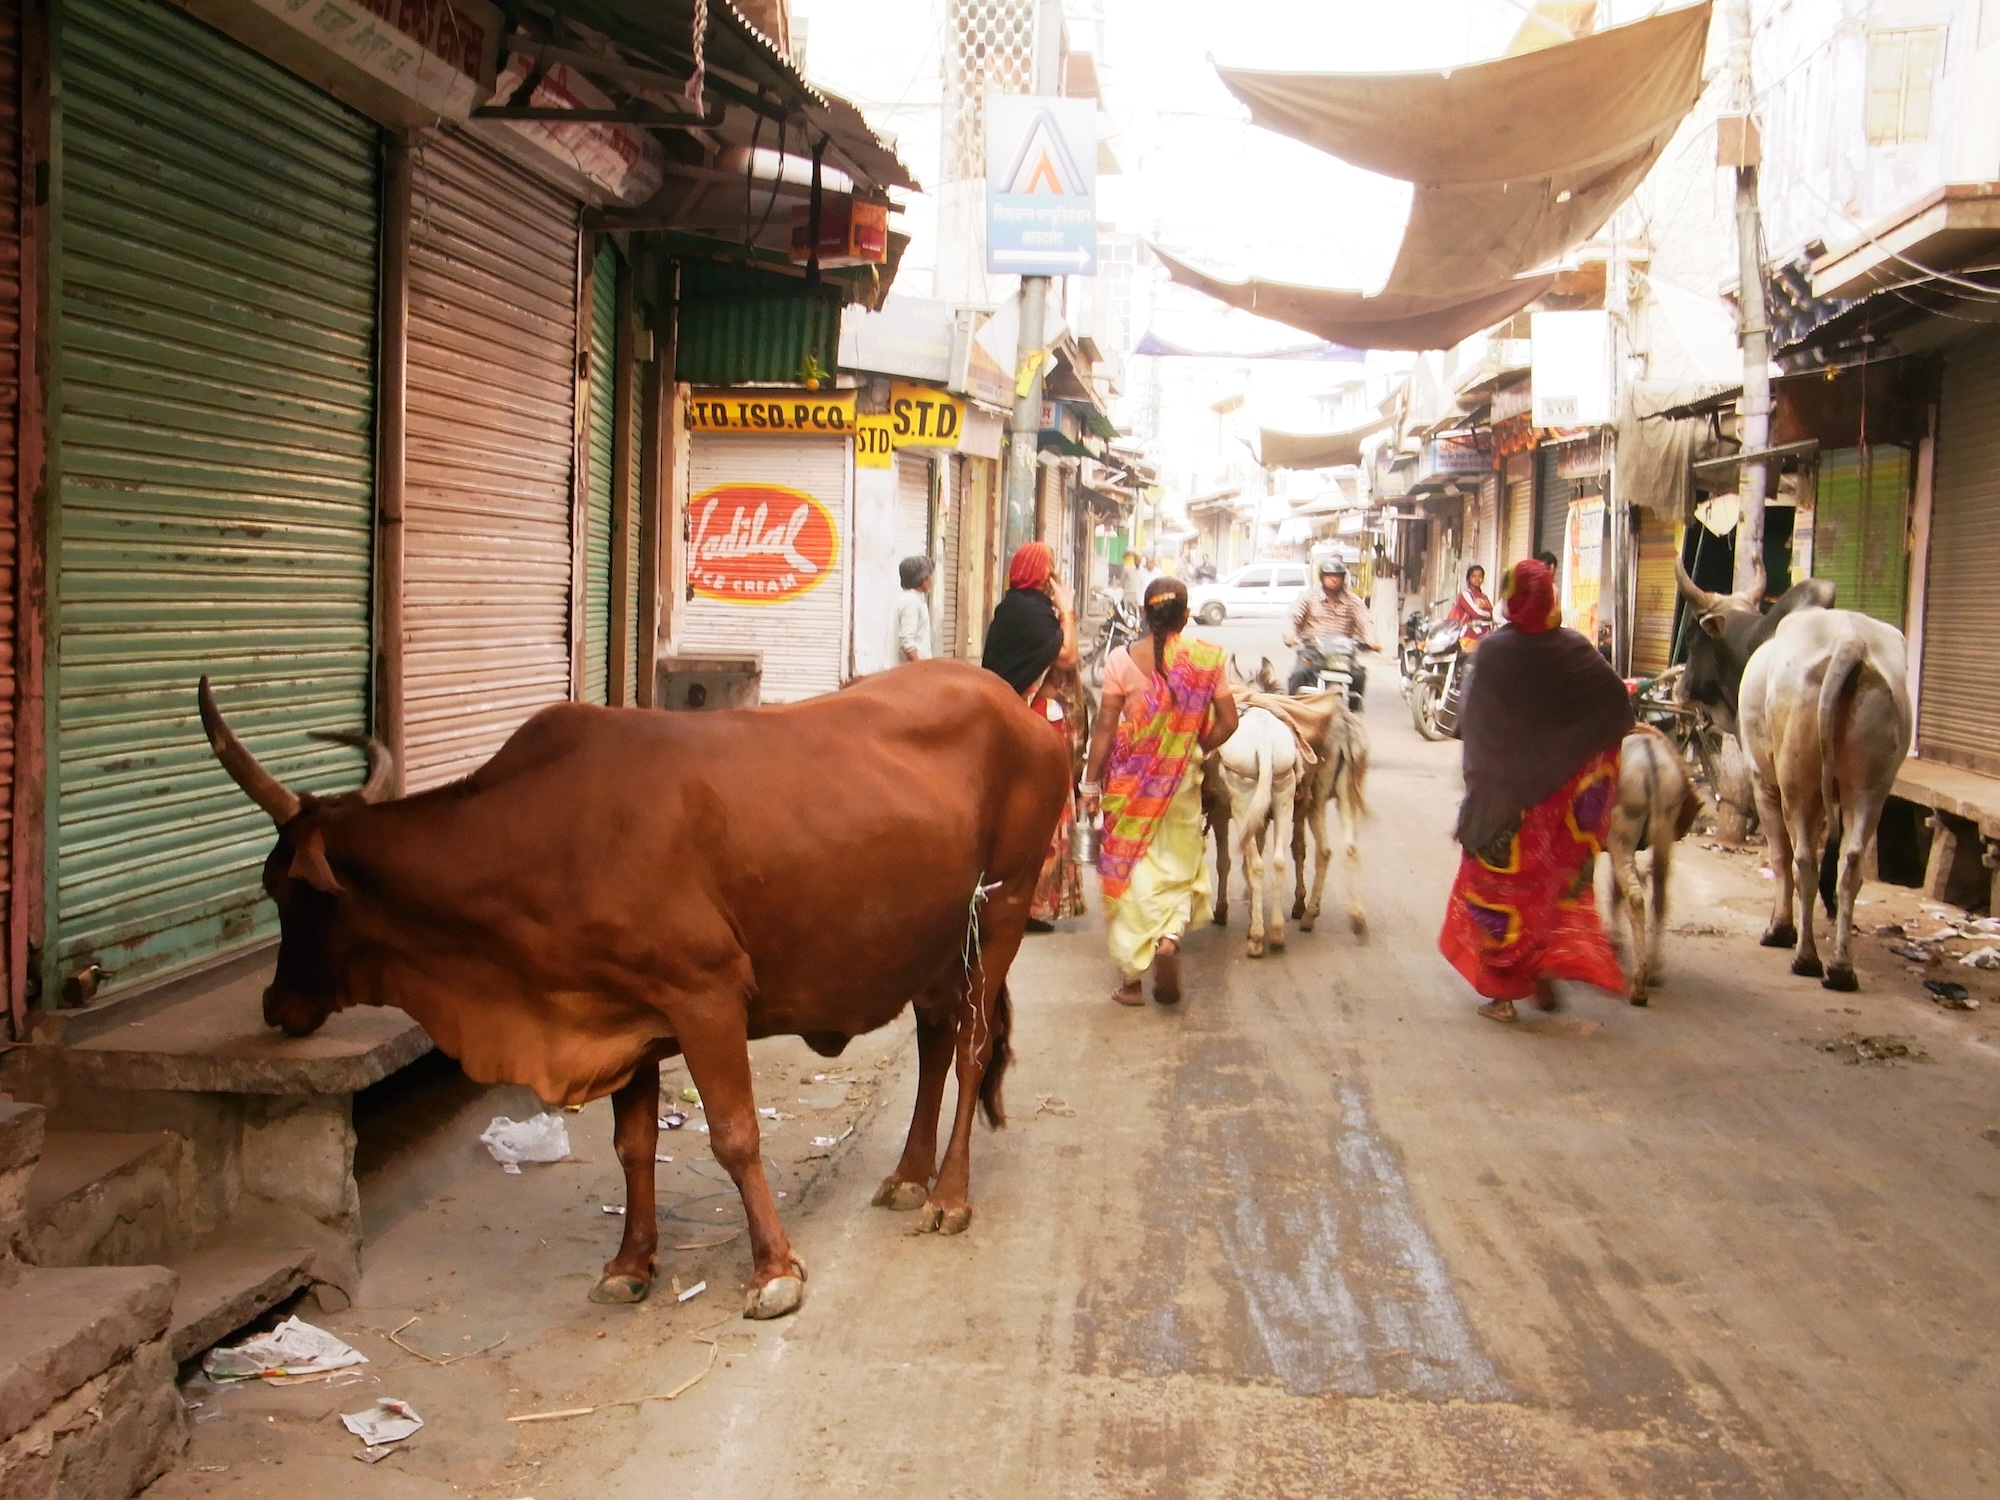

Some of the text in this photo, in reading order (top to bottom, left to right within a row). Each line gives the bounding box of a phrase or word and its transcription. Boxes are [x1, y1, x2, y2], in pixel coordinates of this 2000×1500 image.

[893, 399, 958, 439] S.T.D.
[858, 427, 890, 454] STD
[732, 573, 798, 593] CREAM
